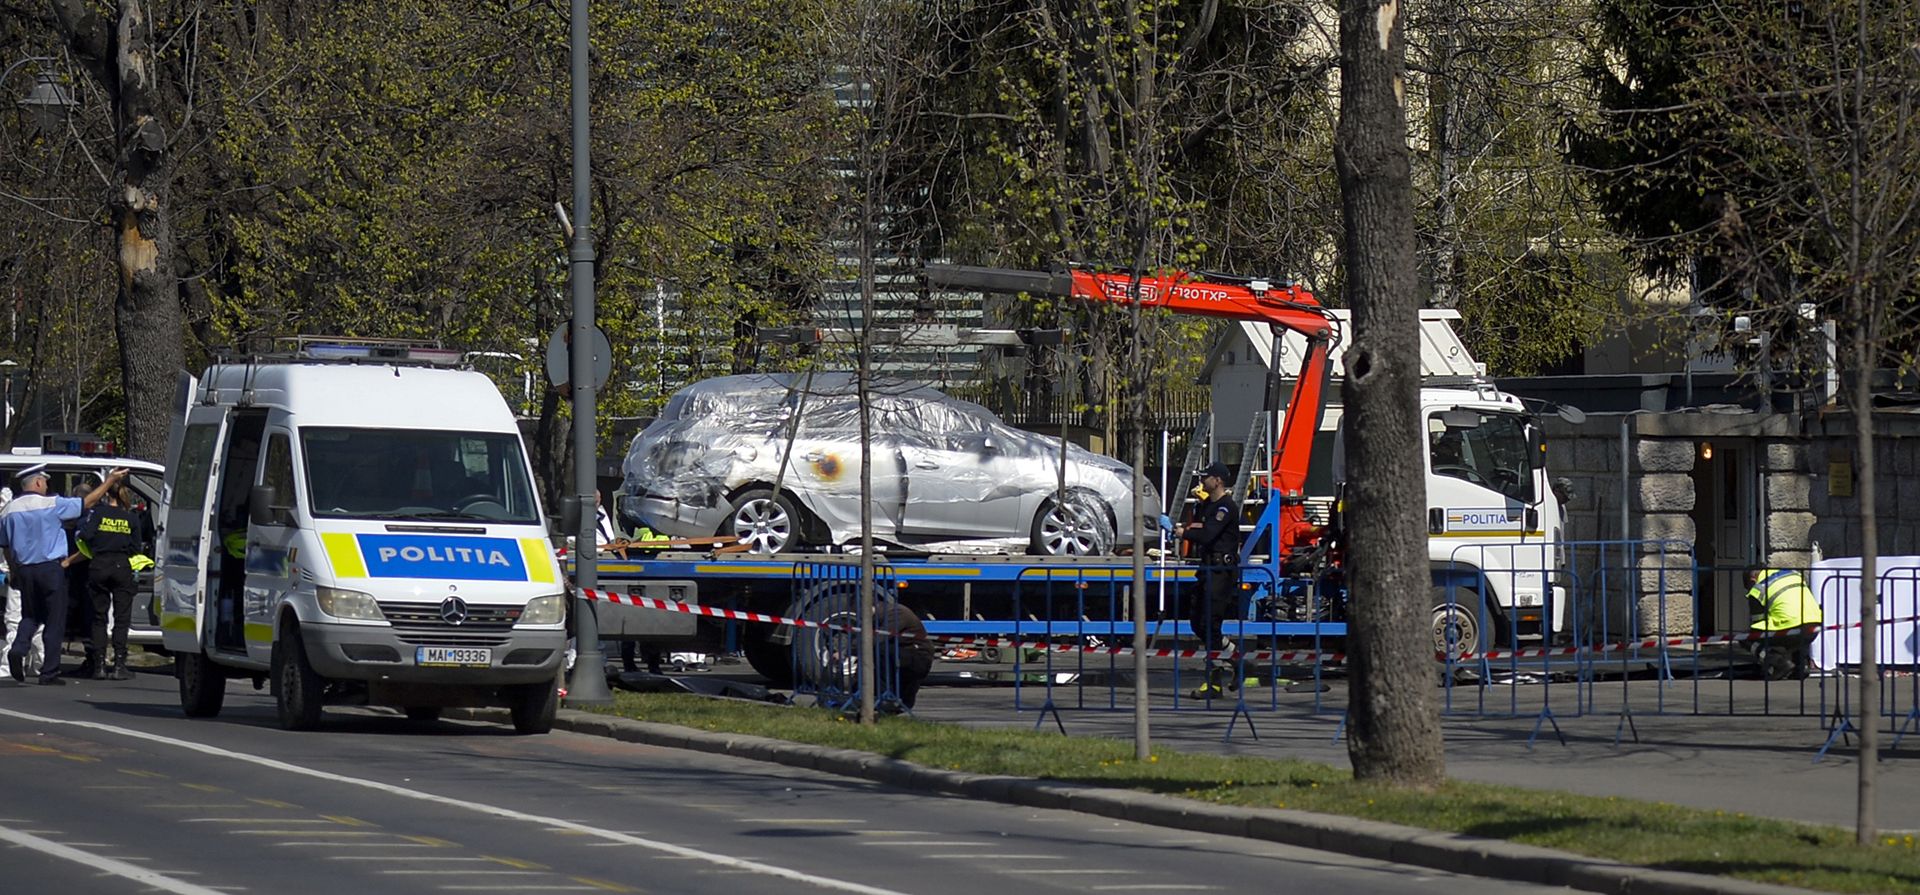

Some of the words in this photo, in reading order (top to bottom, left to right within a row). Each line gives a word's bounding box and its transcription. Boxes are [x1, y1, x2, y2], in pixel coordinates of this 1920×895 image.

[1105, 283, 1154, 300] FASI
[1463, 514, 1507, 524] POLITIA
[378, 546, 510, 567] POLITIA
